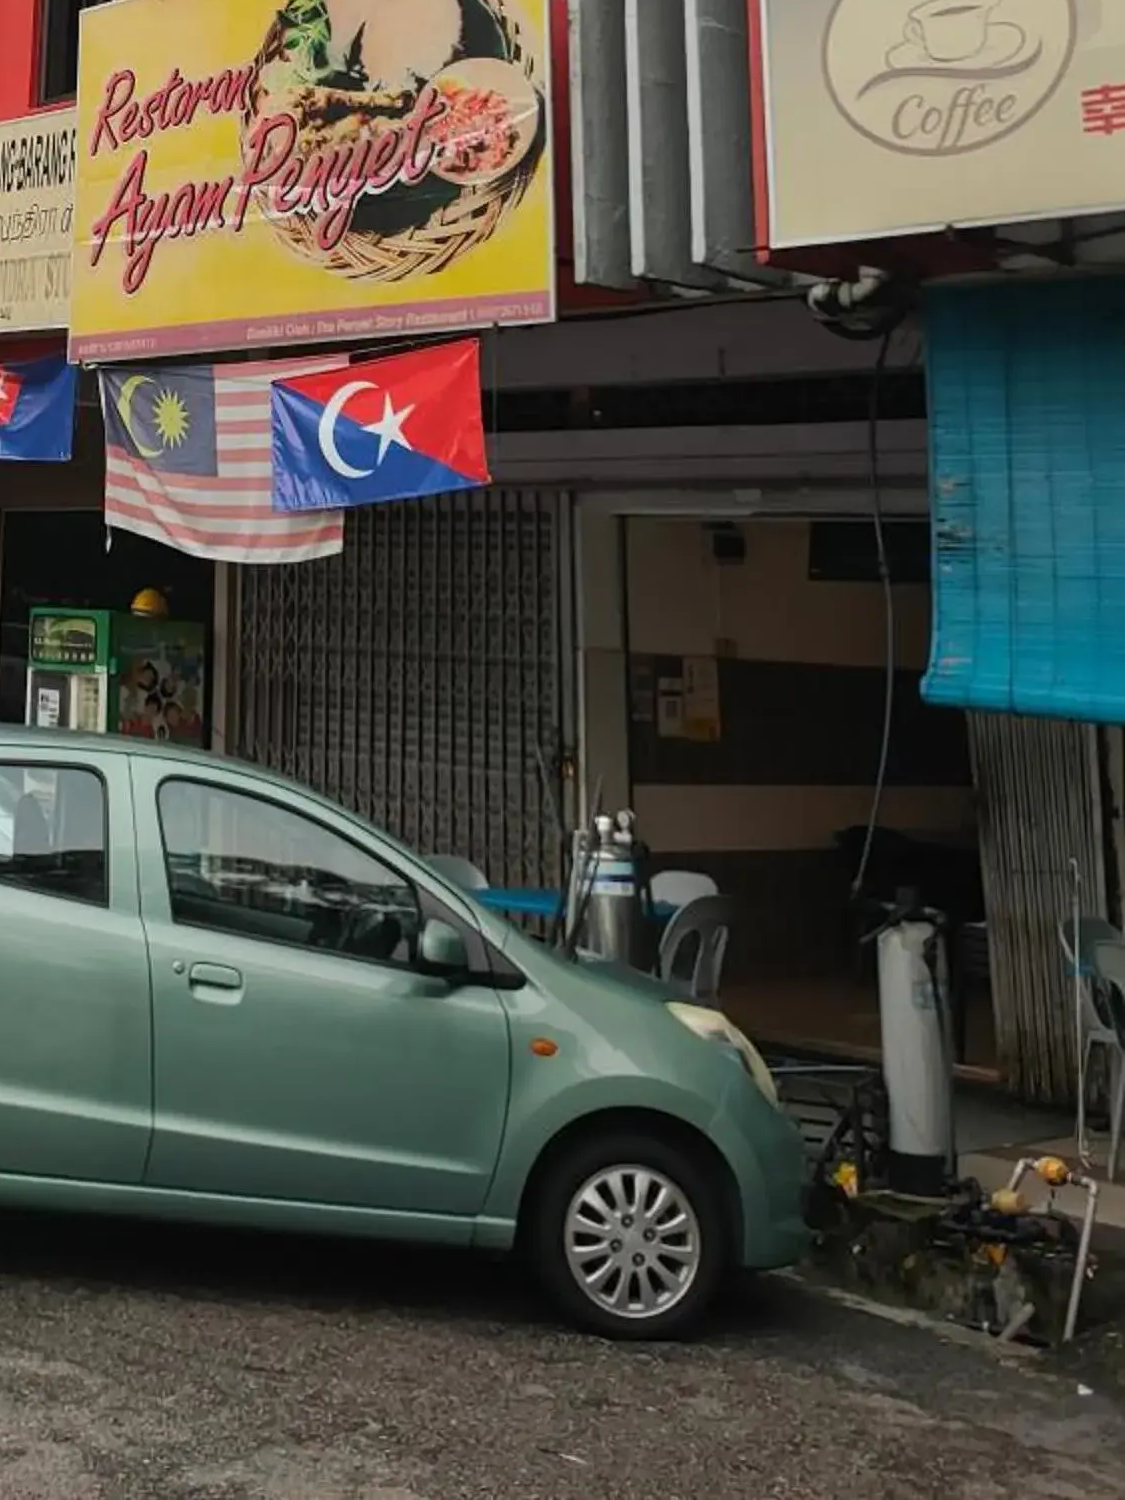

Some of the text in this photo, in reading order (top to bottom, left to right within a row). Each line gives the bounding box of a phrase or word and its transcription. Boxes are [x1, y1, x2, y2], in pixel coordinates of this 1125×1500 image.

[89, 65, 259, 157] Restoran
[891, 82, 1019, 149] Coffee
[91, 87, 448, 295] Ayam Penyet
